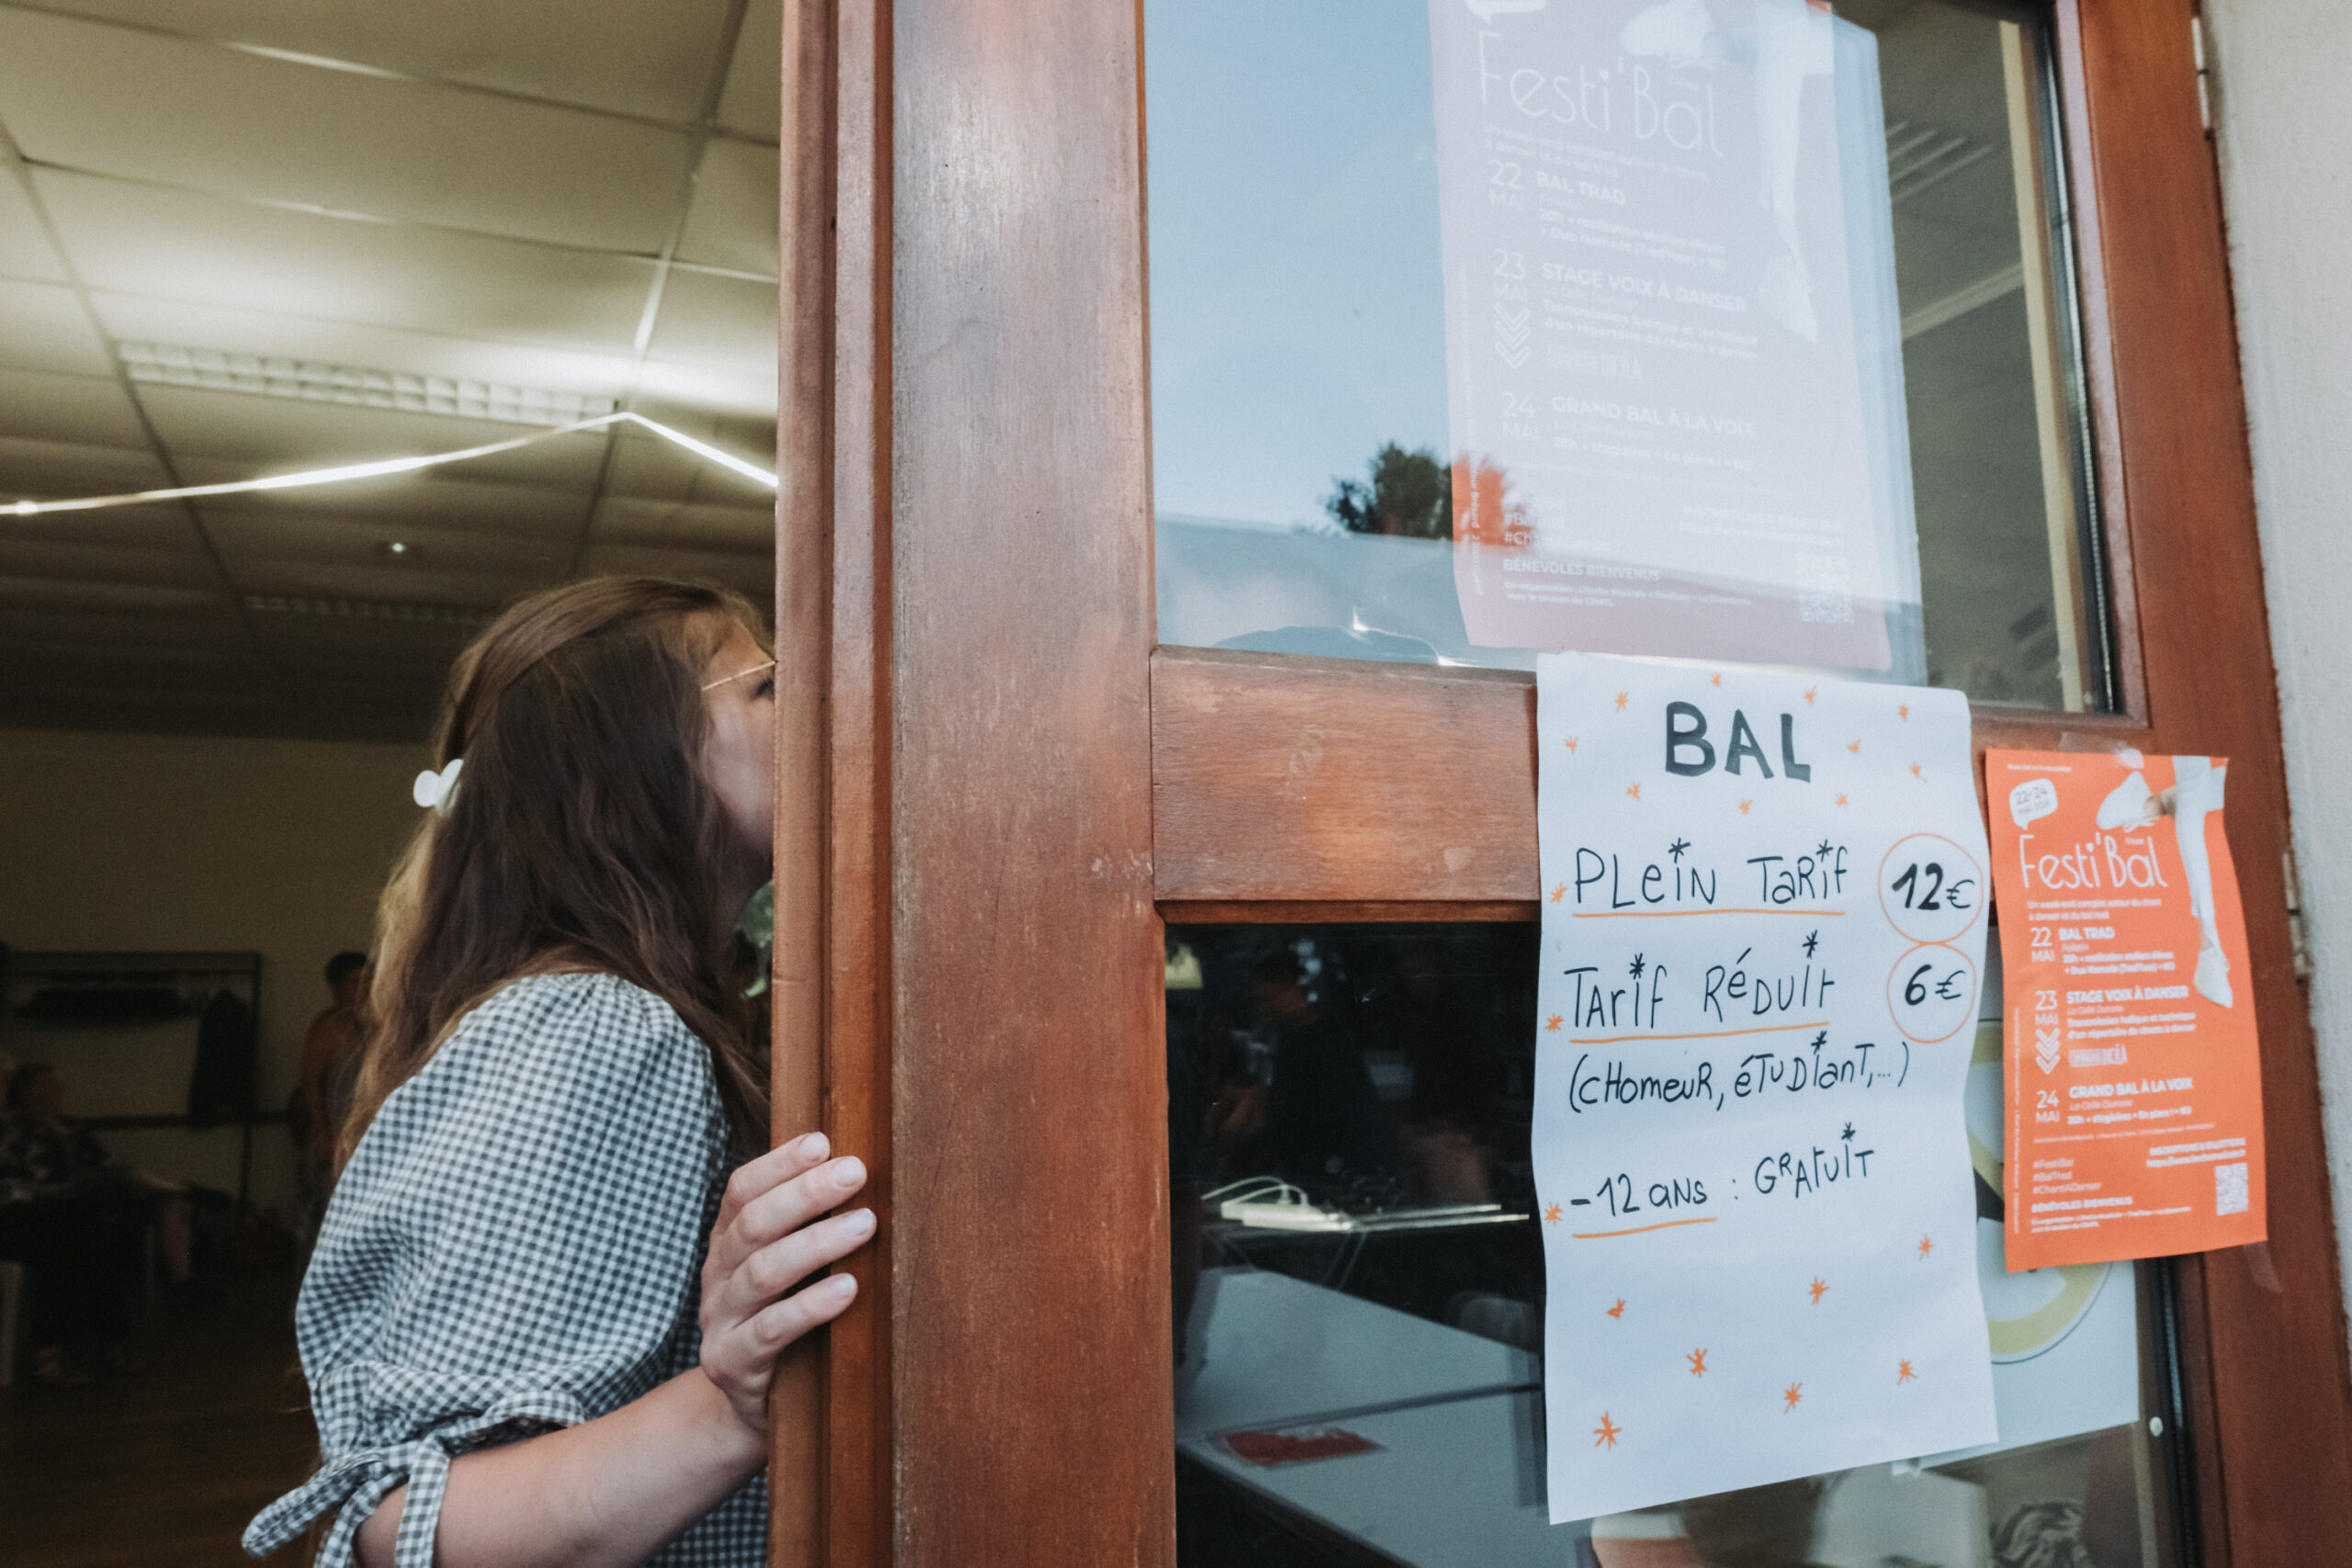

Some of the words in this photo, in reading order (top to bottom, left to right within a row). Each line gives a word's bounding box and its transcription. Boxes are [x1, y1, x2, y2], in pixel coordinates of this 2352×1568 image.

[1487, 158, 1522, 189] 22
[1537, 171, 1574, 194] BAL
[1575, 180, 1626, 205] TRAD
[1489, 188, 1524, 211] MAI
[1494, 248, 1526, 280] 23
[1493, 280, 1528, 302] MAI
[1543, 262, 1603, 288] STAGE
[1608, 275, 1654, 297] VOIX
[1675, 285, 1747, 312] DANSER
[1502, 391, 1537, 420] 24
[1552, 396, 1621, 421] GRAND
[1627, 405, 1664, 426] BAL
[1685, 414, 1711, 433] LA
[1712, 417, 1755, 436] VOIX
[1502, 421, 1540, 441] MAI
[1503, 557, 1584, 576] BÉNÉVOLES
[1586, 564, 1661, 581] BIENVENUS
[1665, 701, 1811, 783] BAL
[1892, 863, 1975, 911] 12€
[2030, 927, 2052, 947] 22
[2059, 928, 2083, 941] BAL
[2083, 926, 2115, 940] TRAD
[2031, 949, 2055, 962] MAI
[2035, 990, 2057, 1010] 23
[2067, 990, 2104, 1004] STAGE
[2105, 988, 2132, 1002] VOIX
[2143, 986, 2189, 1000] DANSER
[2035, 1013, 2059, 1026] MAI
[2036, 1089, 2059, 1109] 24
[2069, 1084, 2113, 1099] GRAND
[2116, 1082, 2139, 1095] BAL
[2151, 1080, 2165, 1092] LA
[2166, 1077, 2193, 1090] VOIX
[2035, 1111, 2060, 1122] MAI
